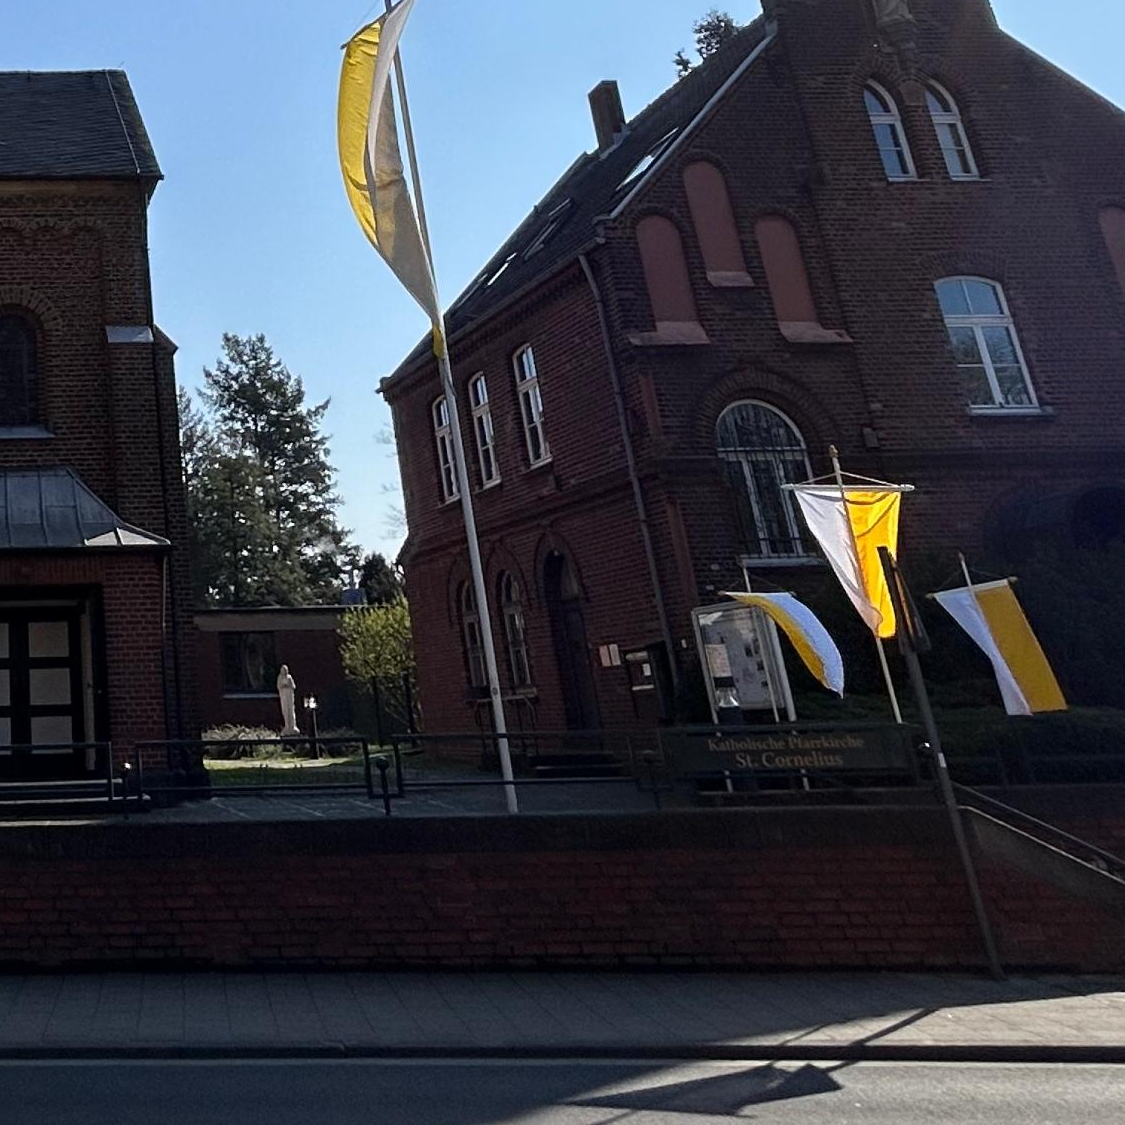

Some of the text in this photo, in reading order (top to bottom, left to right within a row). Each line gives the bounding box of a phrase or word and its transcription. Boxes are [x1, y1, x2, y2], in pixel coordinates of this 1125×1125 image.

[707, 735, 865, 751] Katholische Pfarrkirche
[735, 750, 844, 768] St. Cornelius
